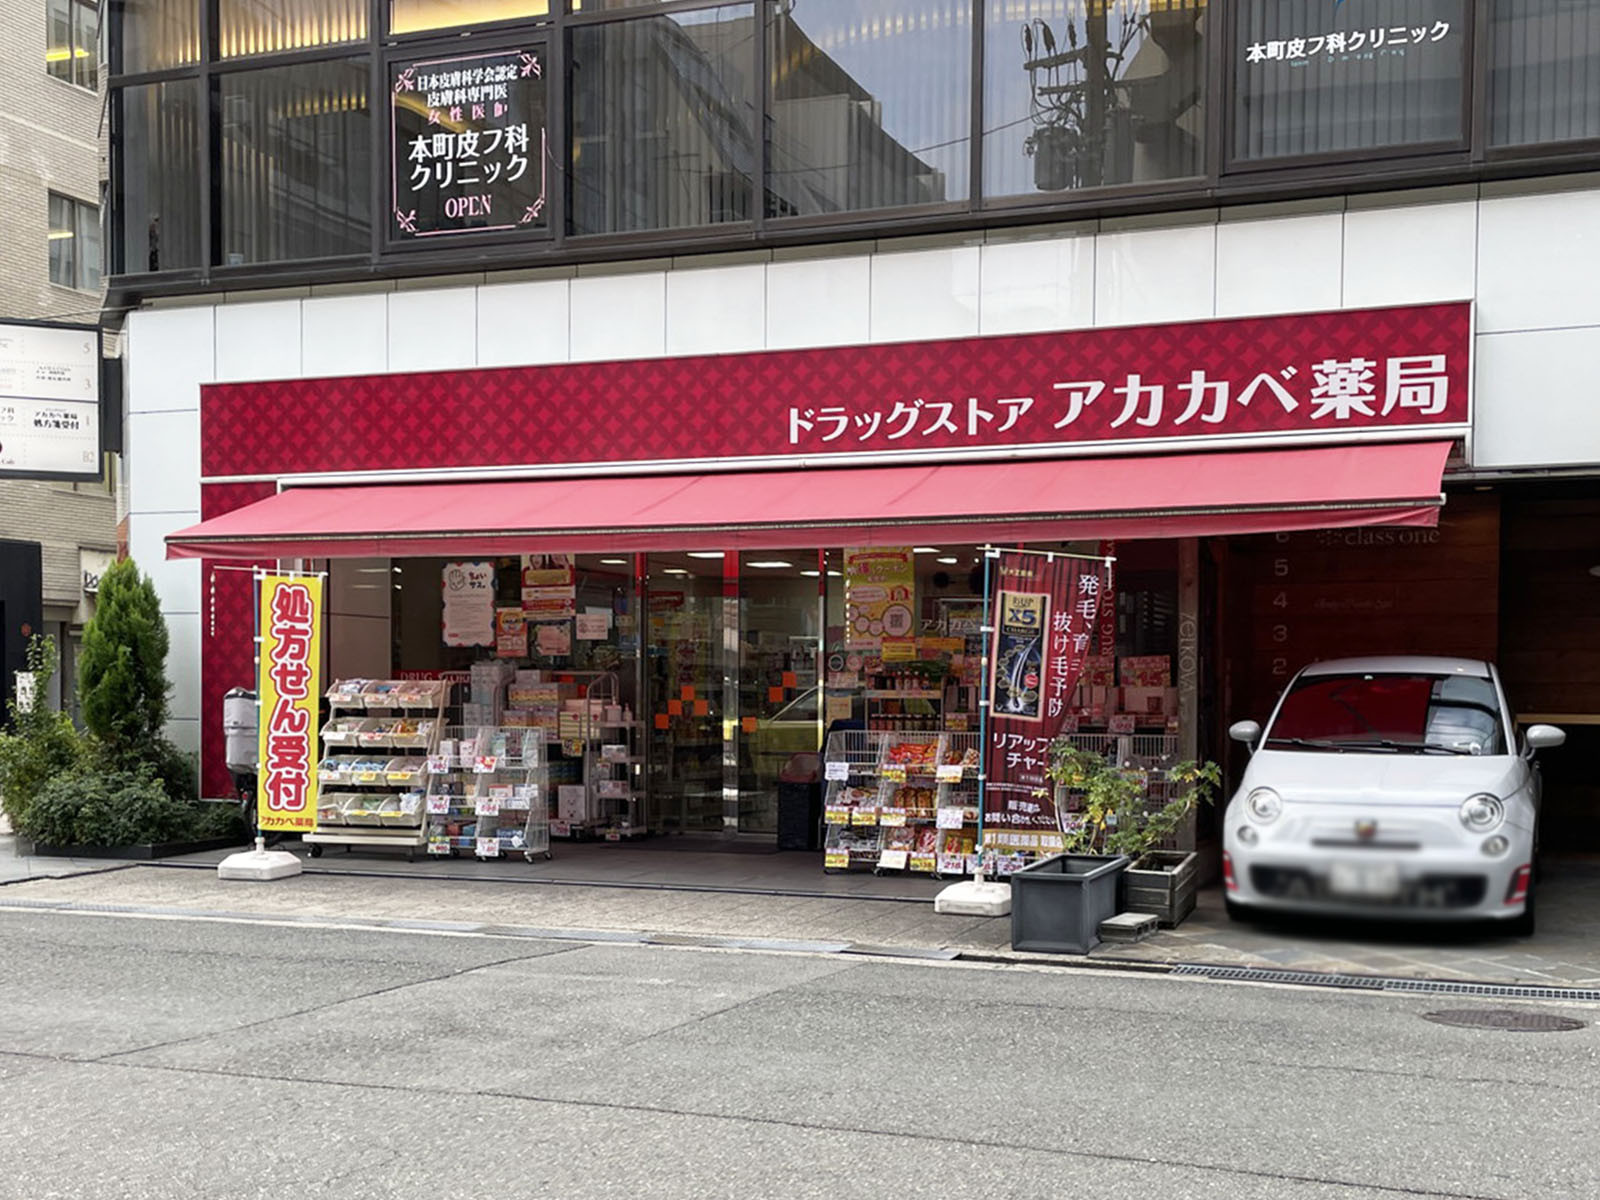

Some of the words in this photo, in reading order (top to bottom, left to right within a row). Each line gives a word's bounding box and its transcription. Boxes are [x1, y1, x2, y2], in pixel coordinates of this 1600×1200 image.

[1246, 20, 1450, 63] 本町皮フ科クリニック
[417, 64, 518, 92] 日本皮膚科学会認定
[427, 83, 508, 107] 皮膚科専門医
[408, 123, 530, 163] 本町皮フ科
[410, 154, 529, 191] クリニック
[445, 194, 493, 219] OPEN
[789, 397, 1035, 445] ドラッグストア
[1052, 353, 1448, 430] アカカベ薬局
[1398, 528, 1441, 544] one
[1274, 559, 1289, 576] 5
[1273, 591, 1288, 608] 4
[1008, 607, 1037, 625] X5
[1102, 623, 1114, 660] RUG
[1272, 624, 1288, 642] 3
[1272, 657, 1287, 675] 2
[265, 583, 314, 812] 処方せん受付
